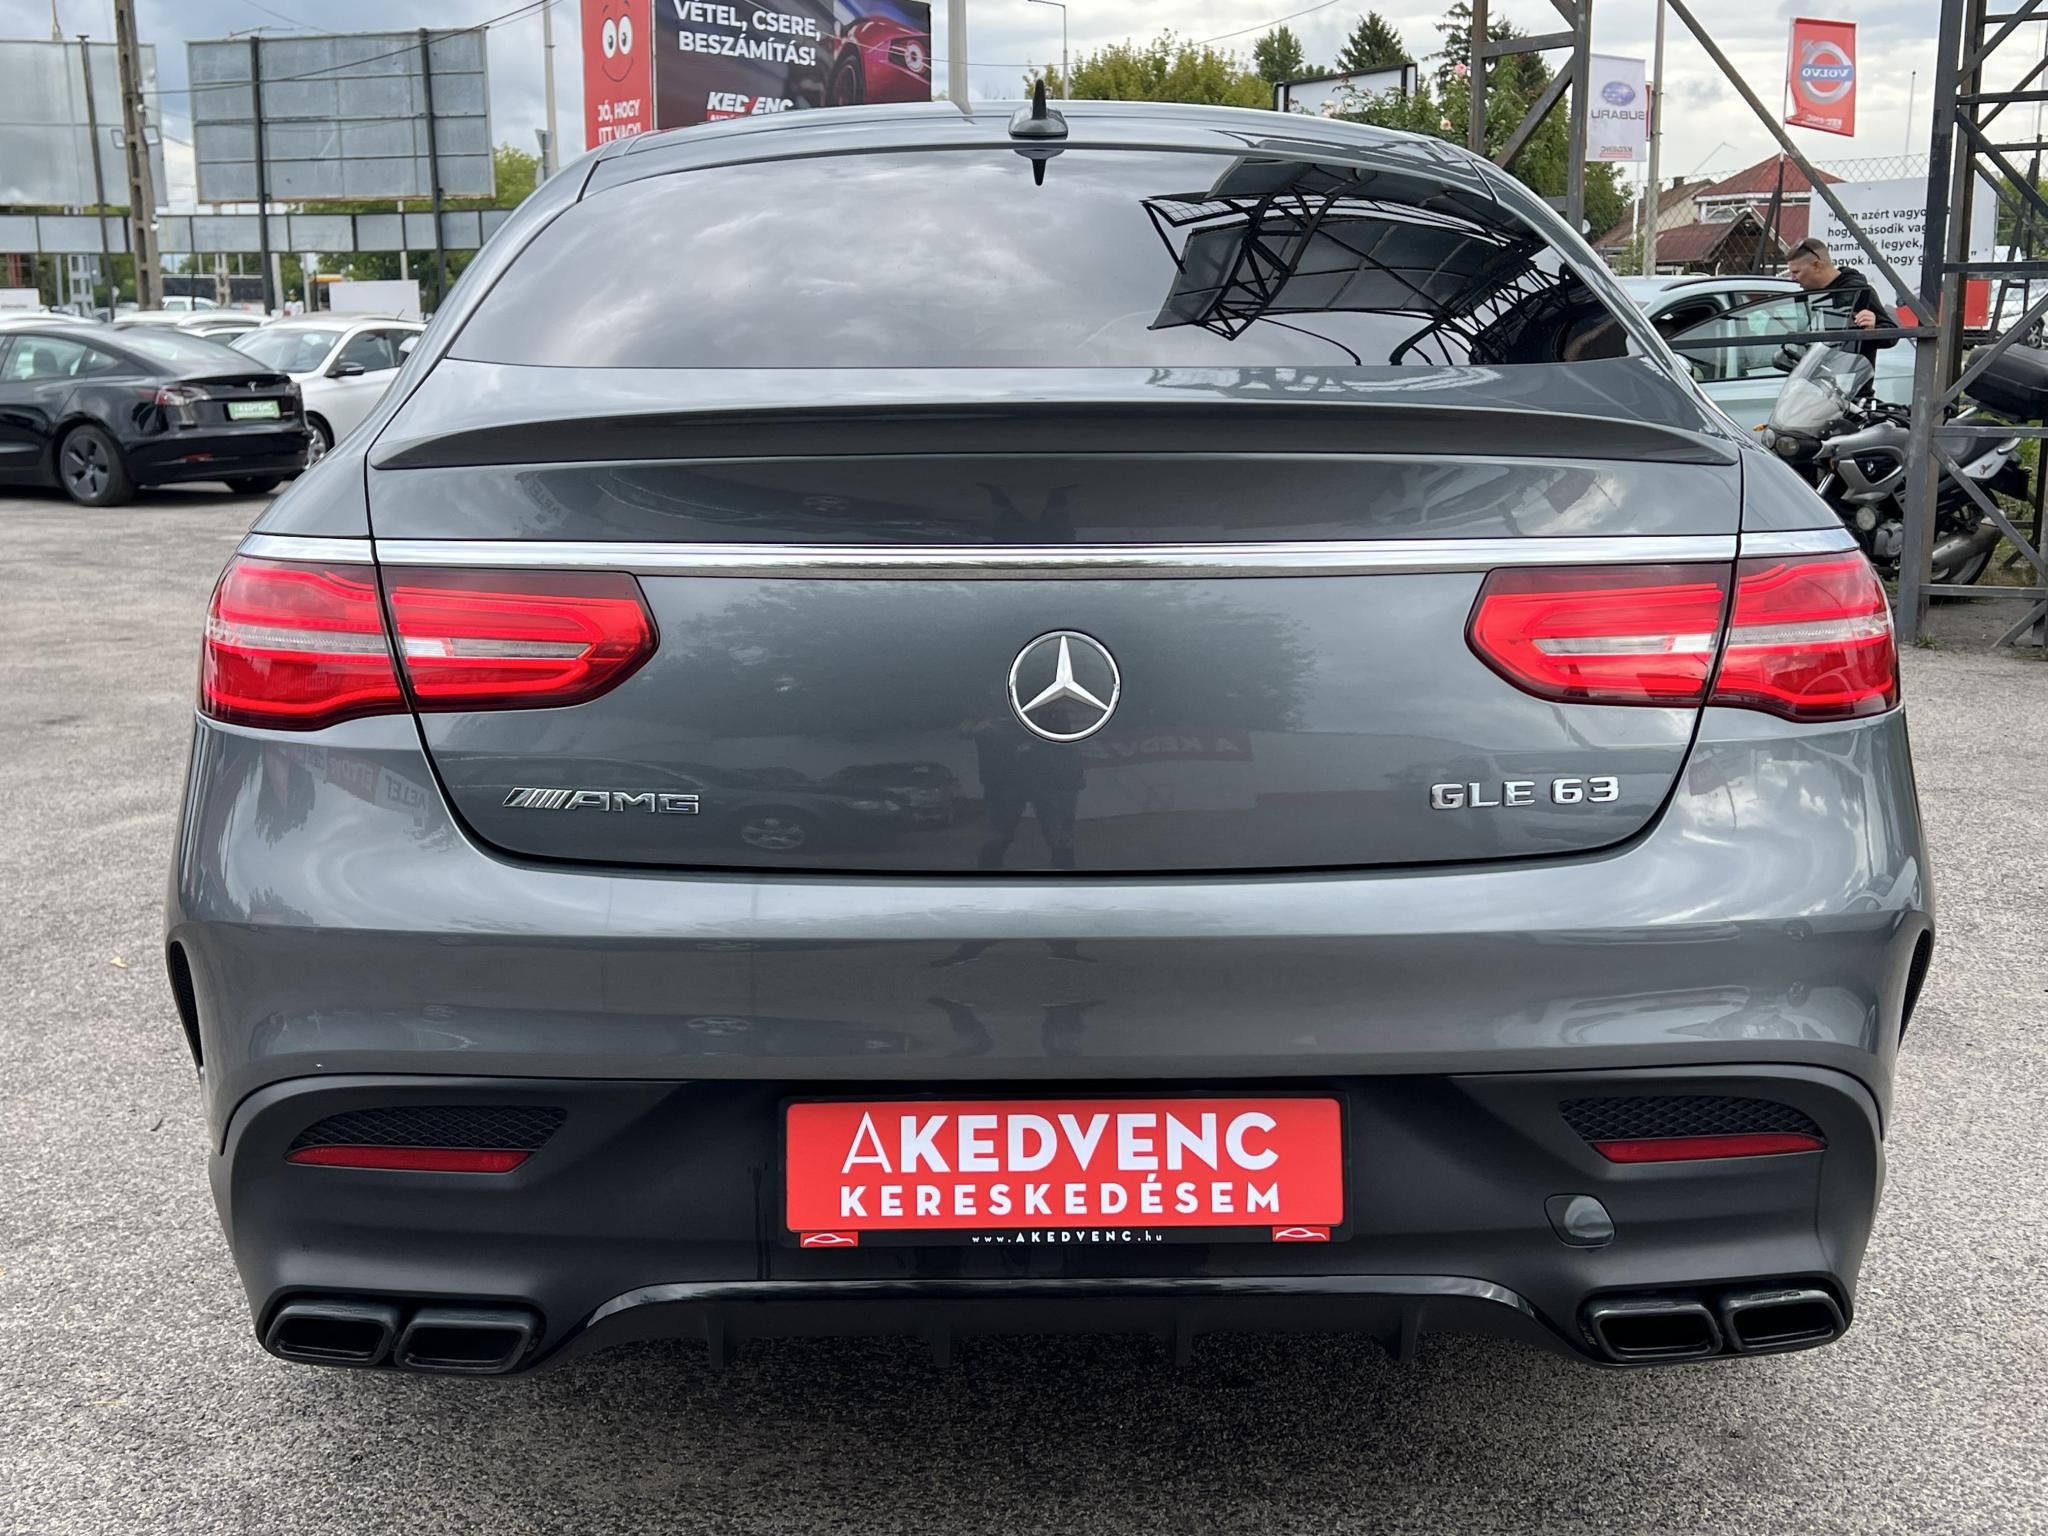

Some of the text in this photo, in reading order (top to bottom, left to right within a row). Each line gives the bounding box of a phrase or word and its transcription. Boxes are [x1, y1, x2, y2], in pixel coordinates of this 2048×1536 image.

[673, 0, 821, 42] VÉTEL, CSERE,
[678, 30, 817, 66] BESZÁMÍTÁS!
[597, 98, 641, 123] JÓ, HOGY
[1861, 208, 1889, 220] azért
[1893, 208, 1927, 220] vagyo
[1881, 237, 1922, 251] legyek,
[1886, 254, 1915, 267] hogy
[566, 790, 700, 815] AMG
[1430, 776, 1620, 810] GLE 63
[840, 1111, 1280, 1174] AKEDVENC
[840, 1173, 1280, 1218] KERESKEDÉSEM
[971, 1230, 1162, 1243] www.AKEDVENC.hu
